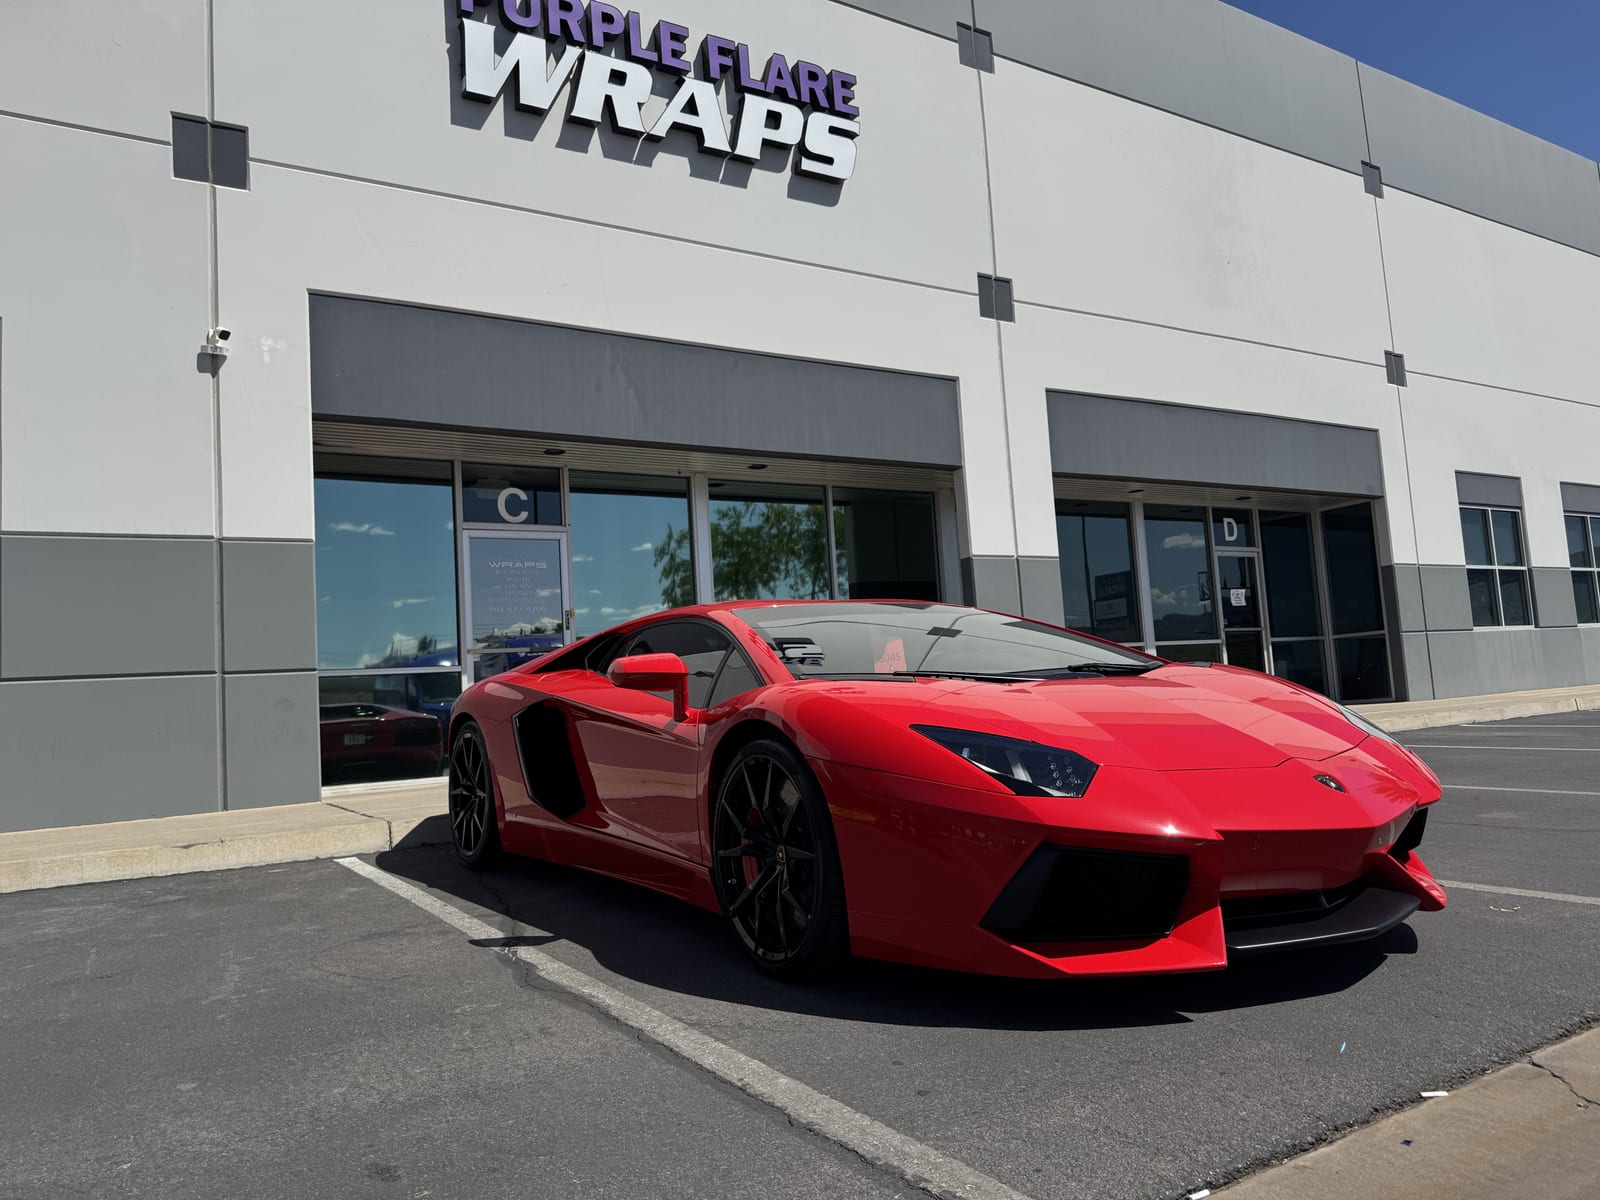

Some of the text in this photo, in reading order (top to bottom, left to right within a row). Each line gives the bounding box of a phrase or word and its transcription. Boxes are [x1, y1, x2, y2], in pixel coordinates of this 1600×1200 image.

[459, 0, 860, 118] URPLE FLARE
[462, 18, 861, 182] WRAPS
[497, 487, 529, 523] C
[1222, 517, 1238, 542] D
[488, 561, 548, 569] WRAPS
